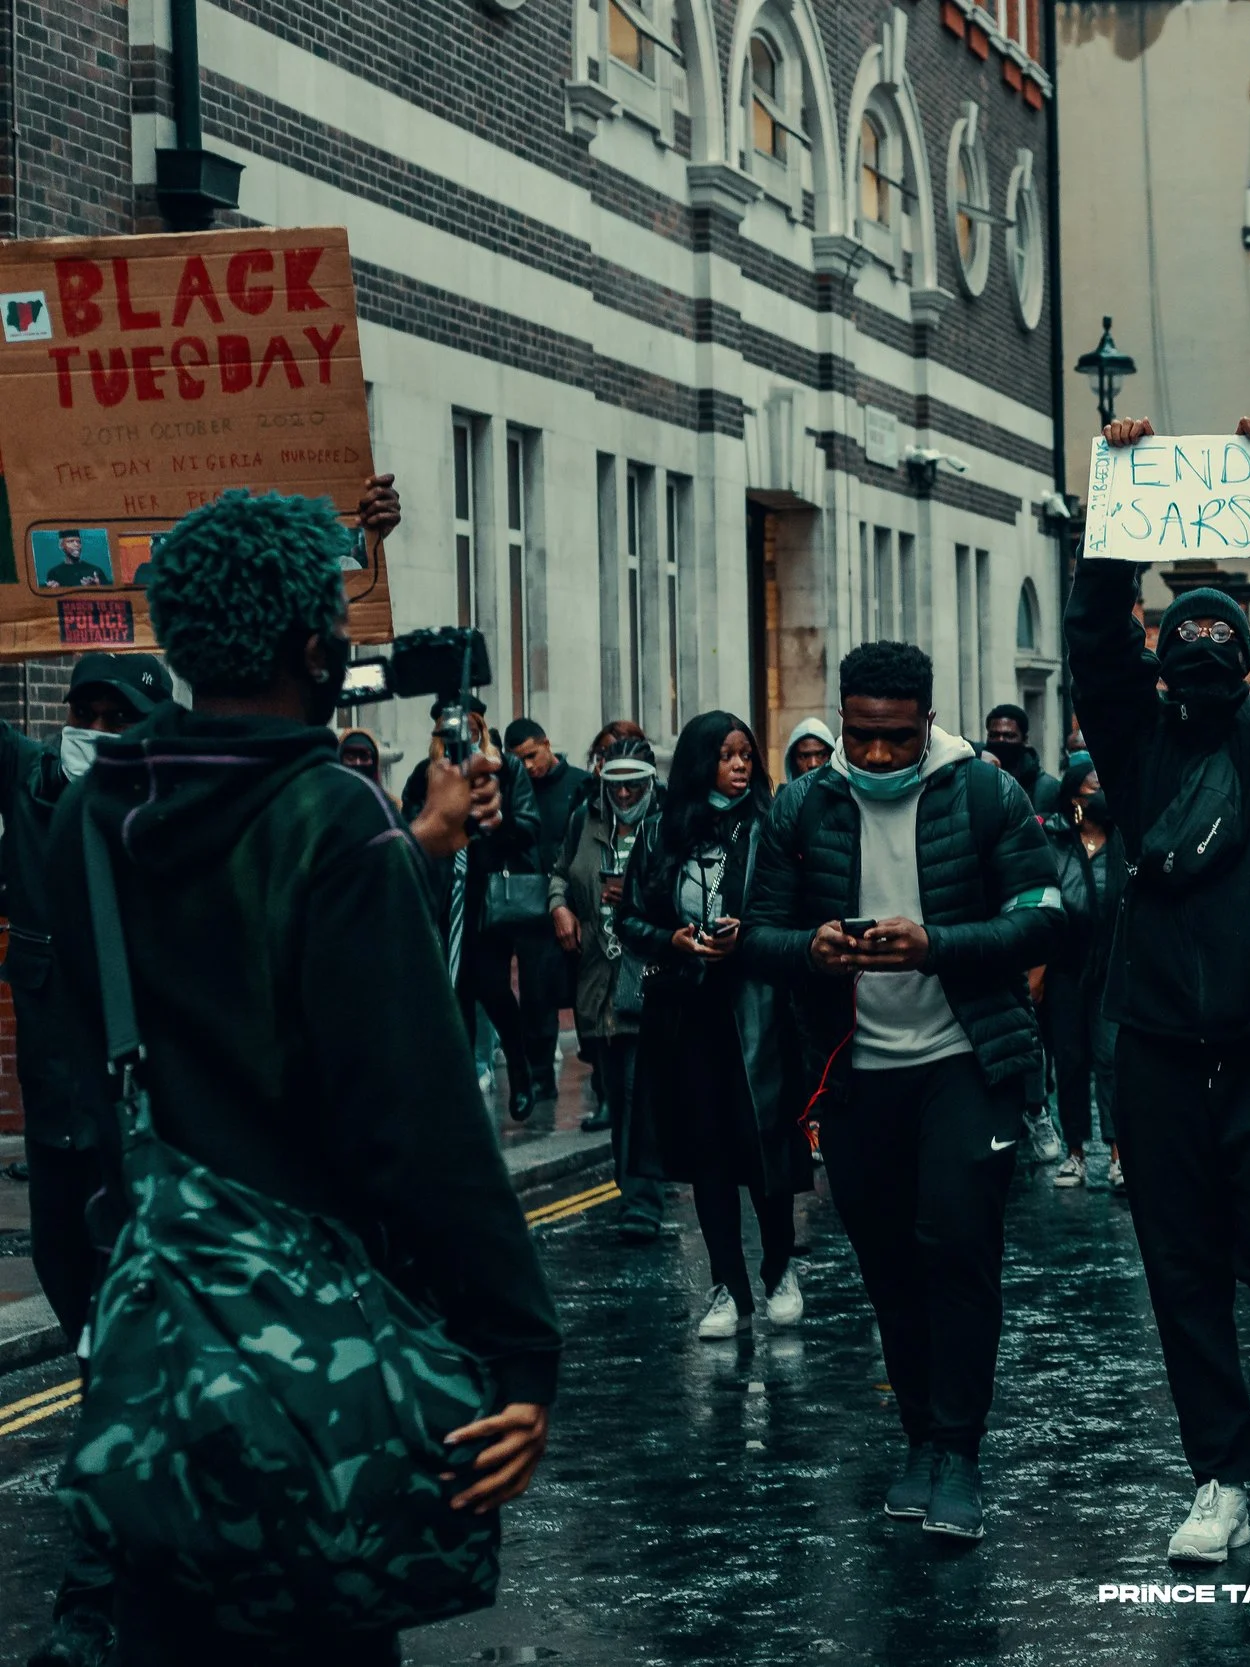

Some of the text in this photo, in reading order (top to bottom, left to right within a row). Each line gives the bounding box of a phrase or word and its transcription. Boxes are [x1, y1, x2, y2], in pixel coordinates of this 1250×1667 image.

[54, 247, 331, 338] BLACK
[49, 325, 345, 409] TUESDAY
[80, 411, 326, 448] 20TH OCTOBER 2020
[53, 445, 360, 484] THE DAY NIGERIA MURDERED
[124, 494, 160, 515] HER
[64, 612, 128, 630] POLICE
[66, 626, 129, 642] BRUTALITY
